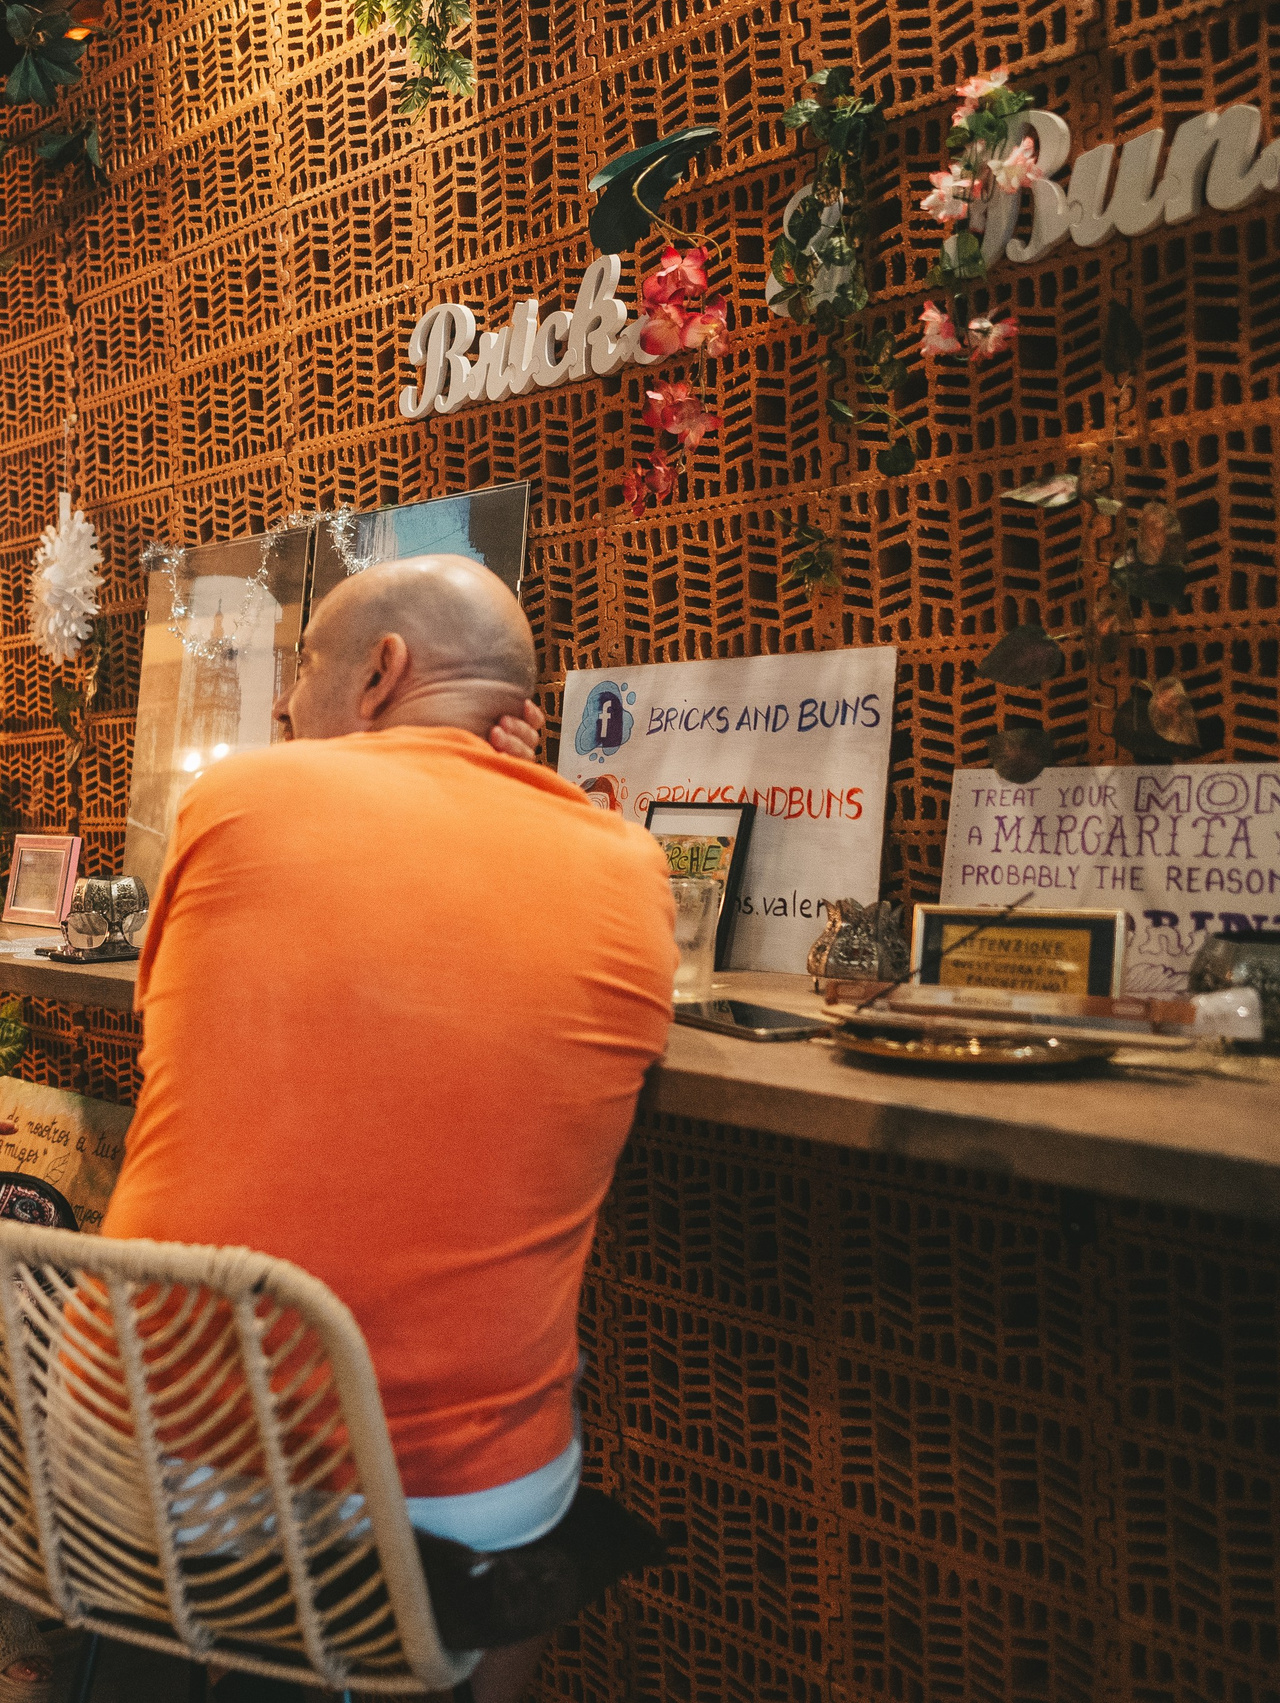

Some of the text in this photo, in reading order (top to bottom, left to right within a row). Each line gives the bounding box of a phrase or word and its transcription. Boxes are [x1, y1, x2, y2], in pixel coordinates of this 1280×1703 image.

[946, 103, 1280, 268] Bun
[646, 694, 881, 735] BRICKS AND BUNS
[971, 787, 1039, 808] TREAT
[1058, 786, 1118, 809] YOUR
[967, 826, 982, 846] A
[991, 814, 1257, 859] MARGARITA
[961, 865, 1080, 889] PROBABLY
[1094, 866, 1144, 892] THE
